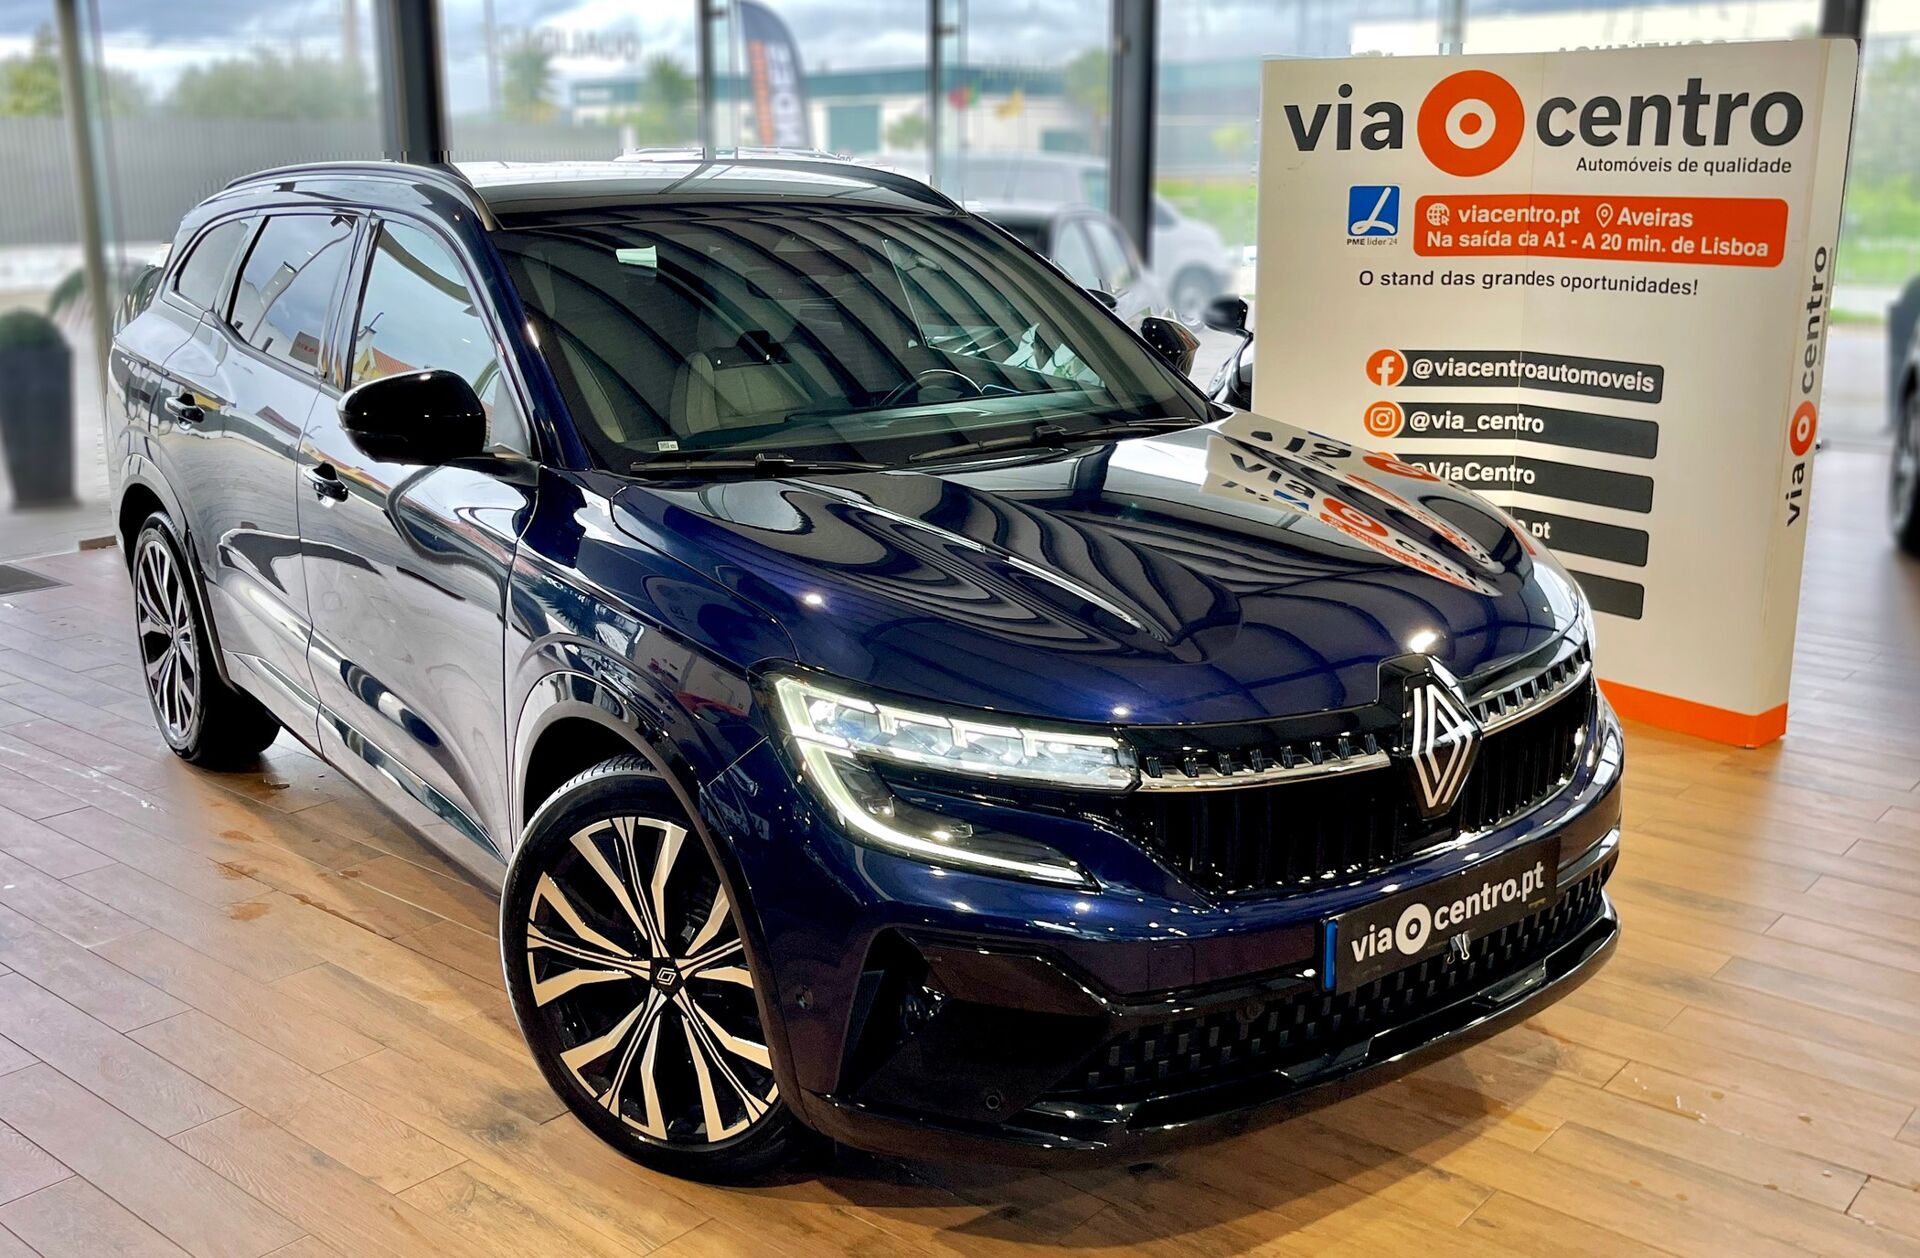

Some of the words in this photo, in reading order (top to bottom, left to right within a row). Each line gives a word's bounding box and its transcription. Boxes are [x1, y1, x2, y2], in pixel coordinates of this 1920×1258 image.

[1283, 83, 1404, 151] via
[1536, 77, 1804, 147] centro
[1576, 156, 1672, 172] Automóveis
[1677, 157, 1698, 172] de
[1703, 157, 1792, 176] qualidade
[1458, 205, 1580, 227] viacentro.pt
[1617, 207, 1693, 228] Aveiras
[1427, 231, 1452, 247] Na
[1459, 231, 1512, 247] saída
[1518, 231, 1539, 247] da
[1543, 232, 1566, 248] A1
[1582, 233, 1596, 249] A
[1600, 233, 1622, 250] 20
[1627, 235, 1666, 252] min.
[1671, 236, 1695, 253] de
[1701, 237, 1769, 256] Lisboa
[1359, 270, 1374, 286] O
[1380, 270, 1434, 286] stand
[1440, 270, 1476, 286] das
[1482, 271, 1555, 290] grandes
[1560, 274, 1699, 296] oportunidades!
[1412, 358, 1655, 393] @viacentroautomoveis
[1785, 462, 1806, 527] via
[1801, 246, 1828, 394] centro
[1409, 411, 1545, 434] @via_centro
[1351, 923, 1393, 962] via
[1434, 861, 1545, 930] centro.pt
